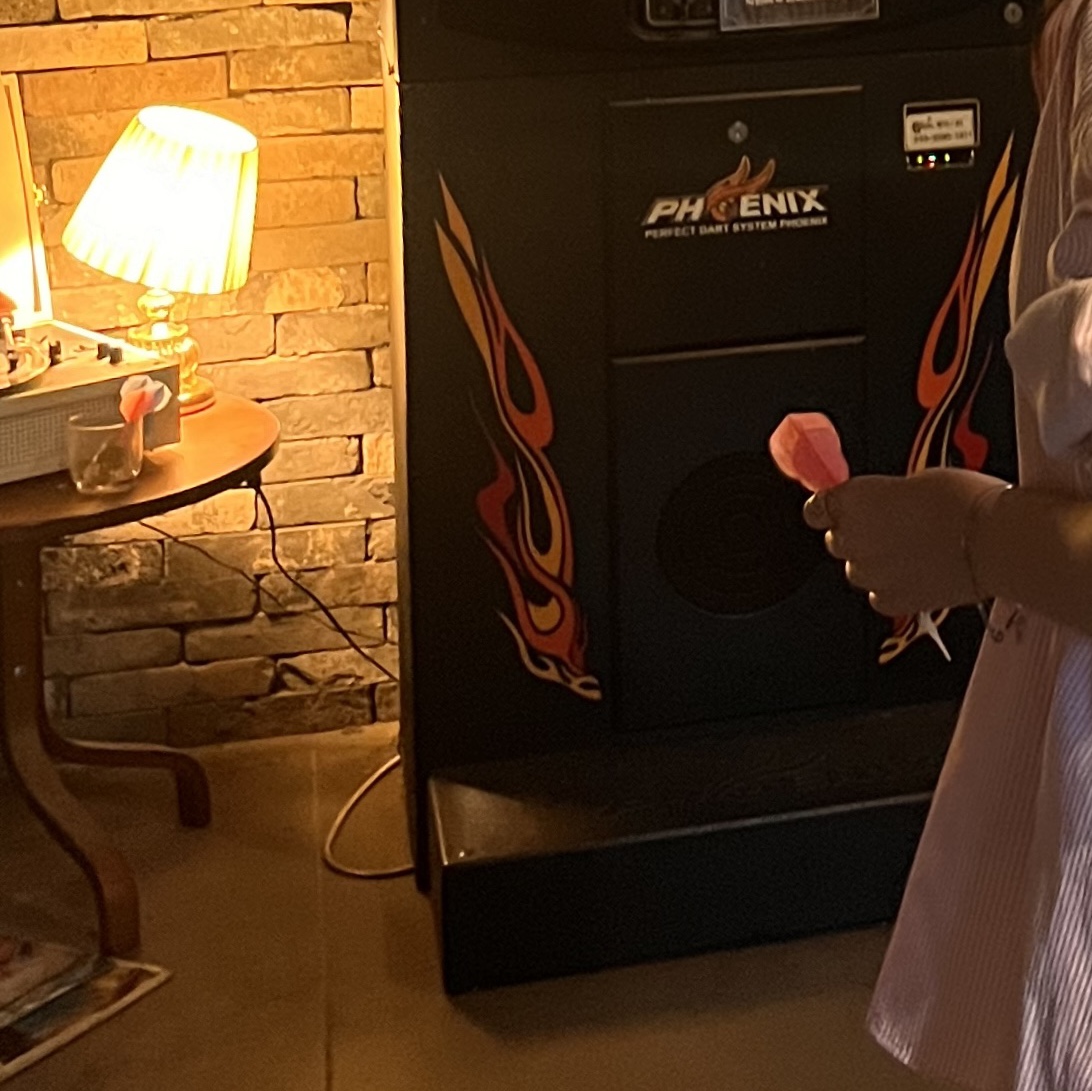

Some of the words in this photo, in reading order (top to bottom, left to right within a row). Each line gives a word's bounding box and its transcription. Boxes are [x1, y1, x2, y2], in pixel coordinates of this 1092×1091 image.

[646, 188, 827, 224] PHOENIX
[644, 224, 696, 239] PERFECT
[699, 223, 729, 235] DART
[732, 219, 777, 233] SYSTEM
